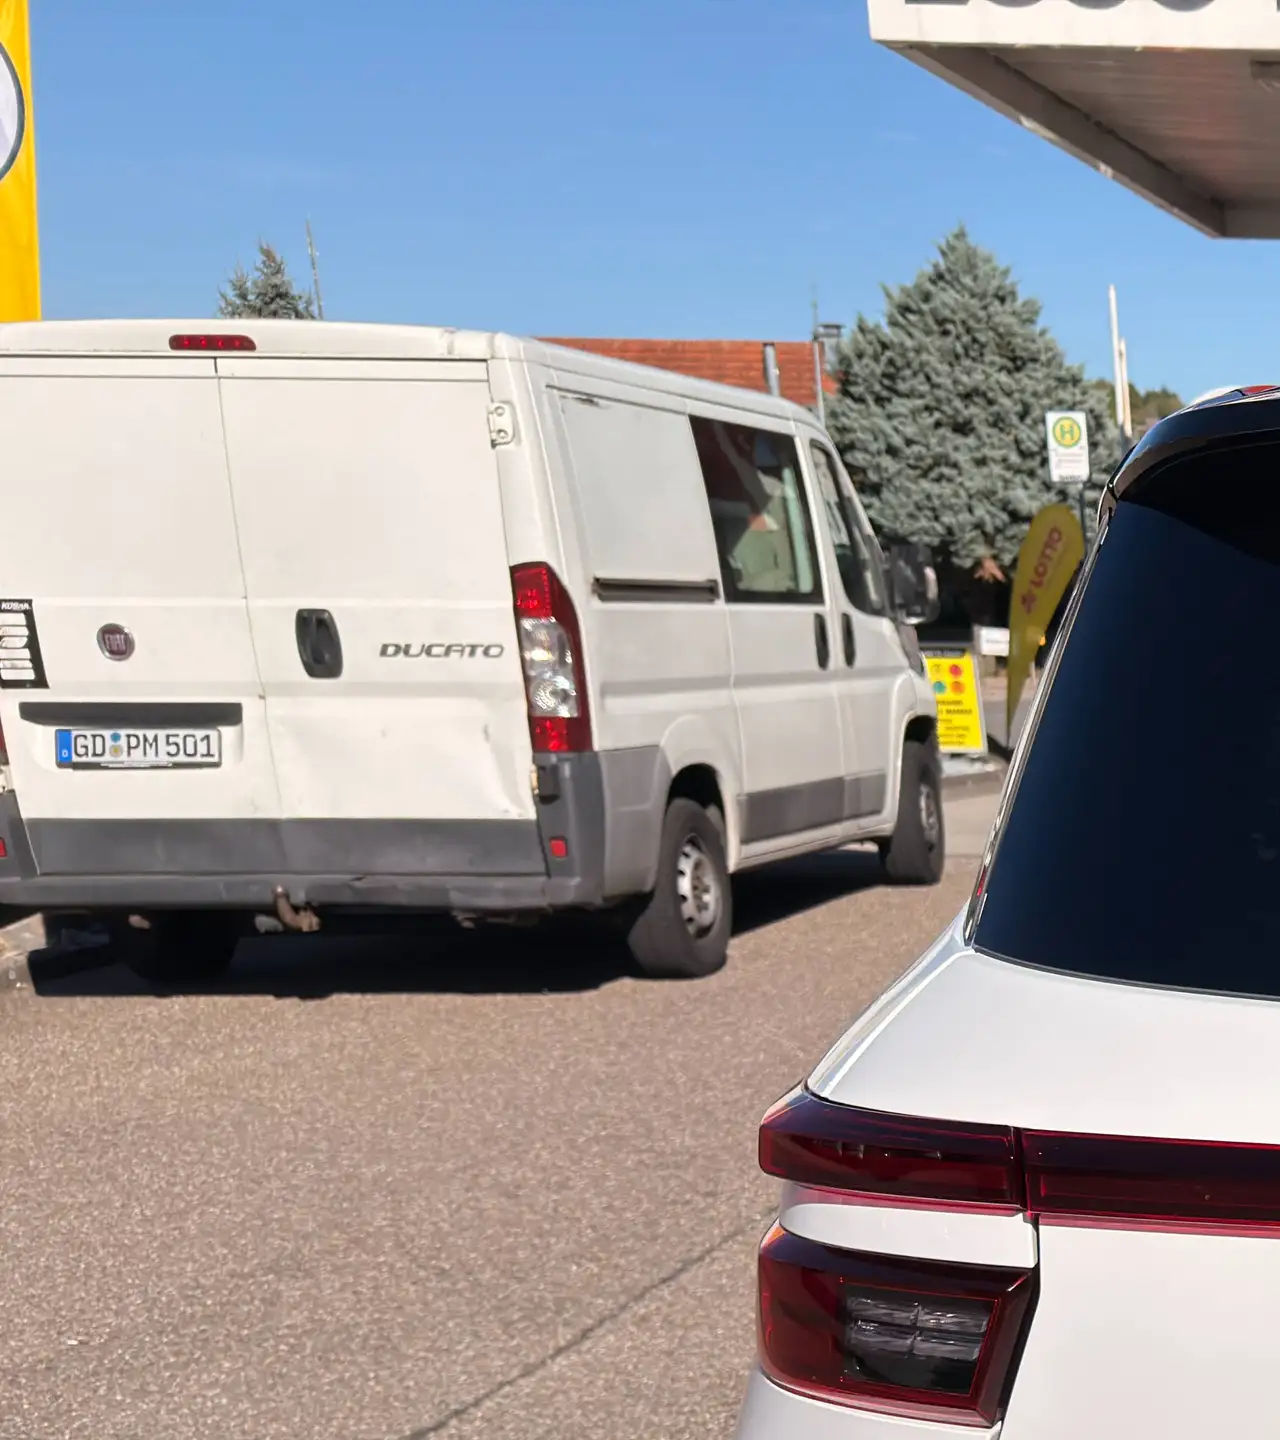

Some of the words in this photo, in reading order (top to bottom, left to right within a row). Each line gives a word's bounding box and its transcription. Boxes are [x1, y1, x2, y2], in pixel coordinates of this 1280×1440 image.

[1030, 525, 1062, 589] LOTTO
[379, 643, 505, 659] DUCATO
[73, 734, 107, 758] GD
[125, 734, 159, 757] PM
[165, 734, 216, 758] 501
